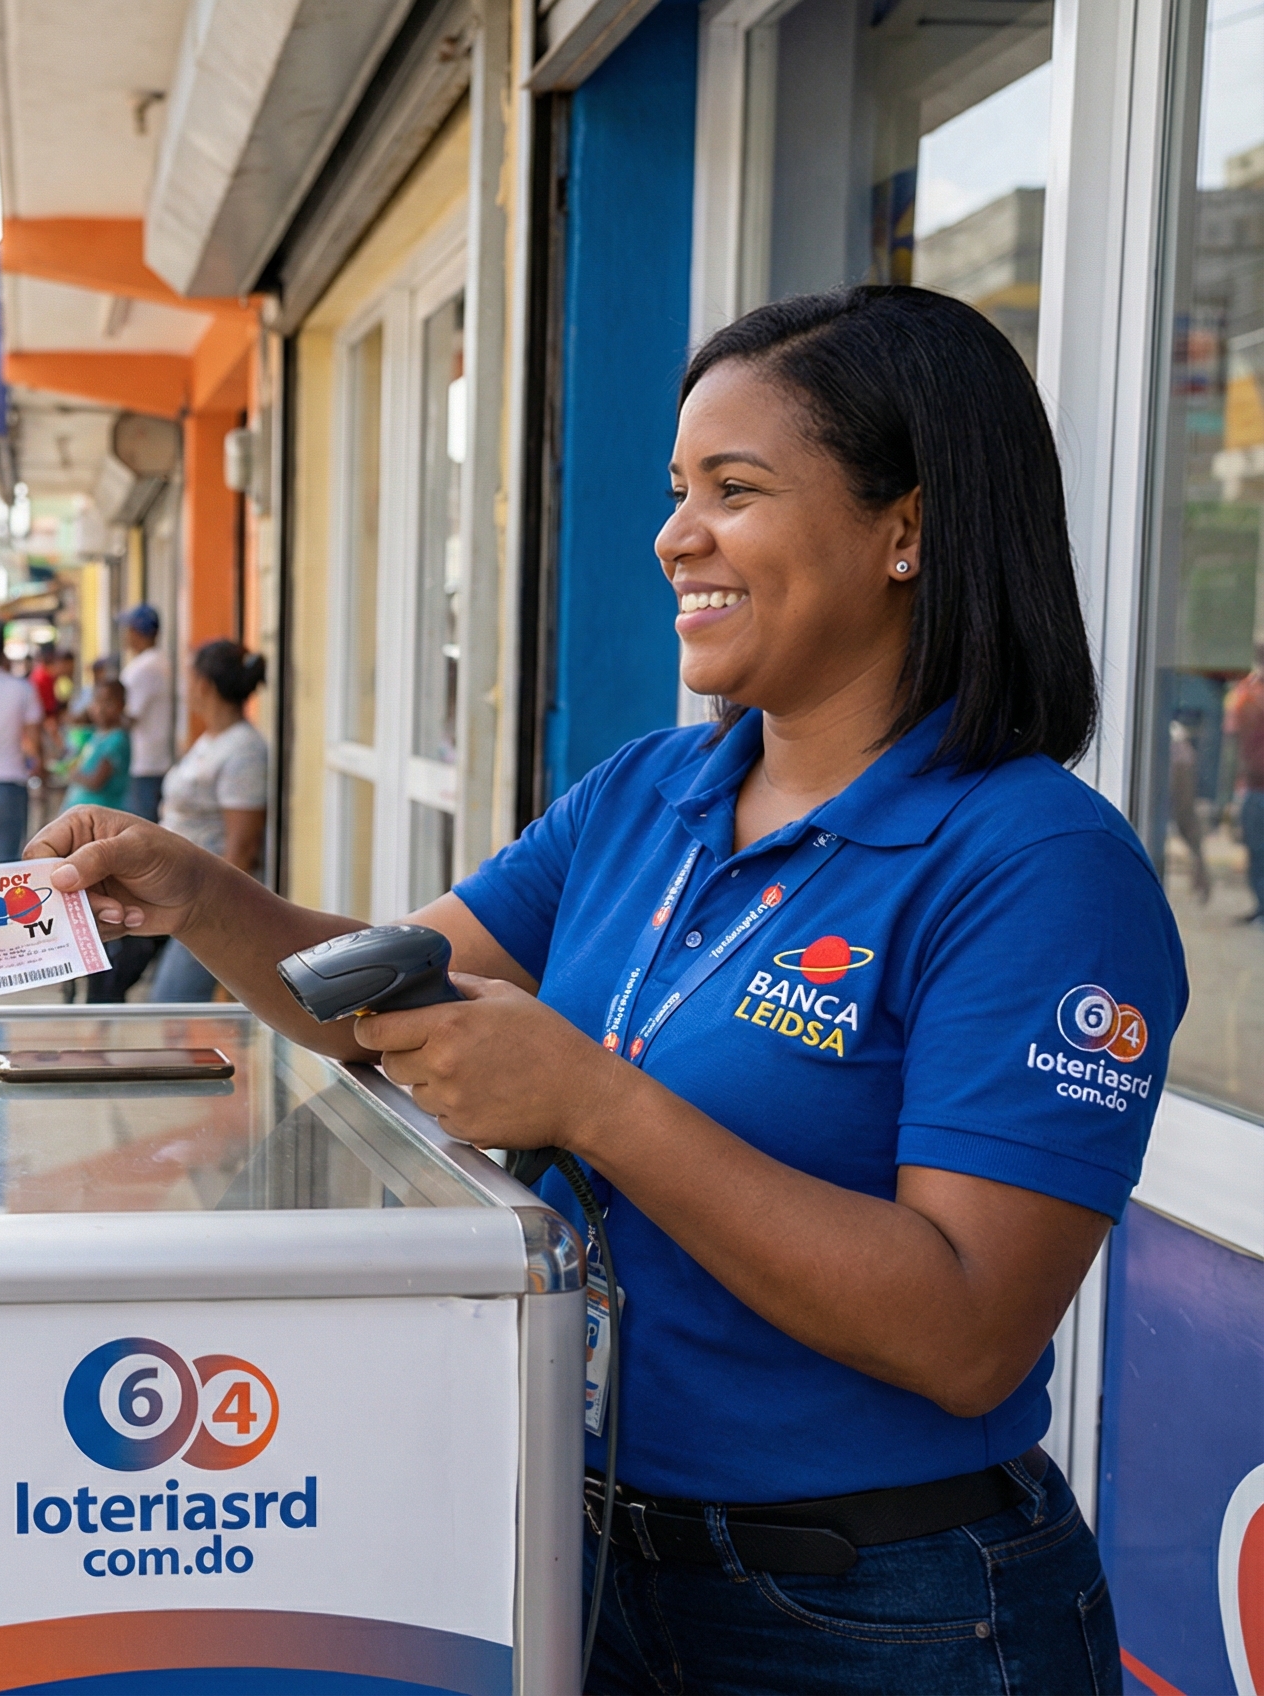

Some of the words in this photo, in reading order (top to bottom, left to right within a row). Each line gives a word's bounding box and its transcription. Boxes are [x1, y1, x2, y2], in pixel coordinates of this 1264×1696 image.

[23, 918, 54, 939] TV
[734, 996, 844, 1057] LEIDSA
[746, 970, 858, 1031] BANCA
[1084, 1003, 1105, 1029] 6
[1122, 1020, 1140, 1048] 4
[1027, 1042, 1152, 1099] loteriasrd
[1056, 1082, 1127, 1112] com.do
[118, 1366, 164, 1427] 6
[212, 1381, 257, 1435] 4
[15, 1475, 317, 1535] loteriasrd
[82, 1534, 255, 1577] com.do
